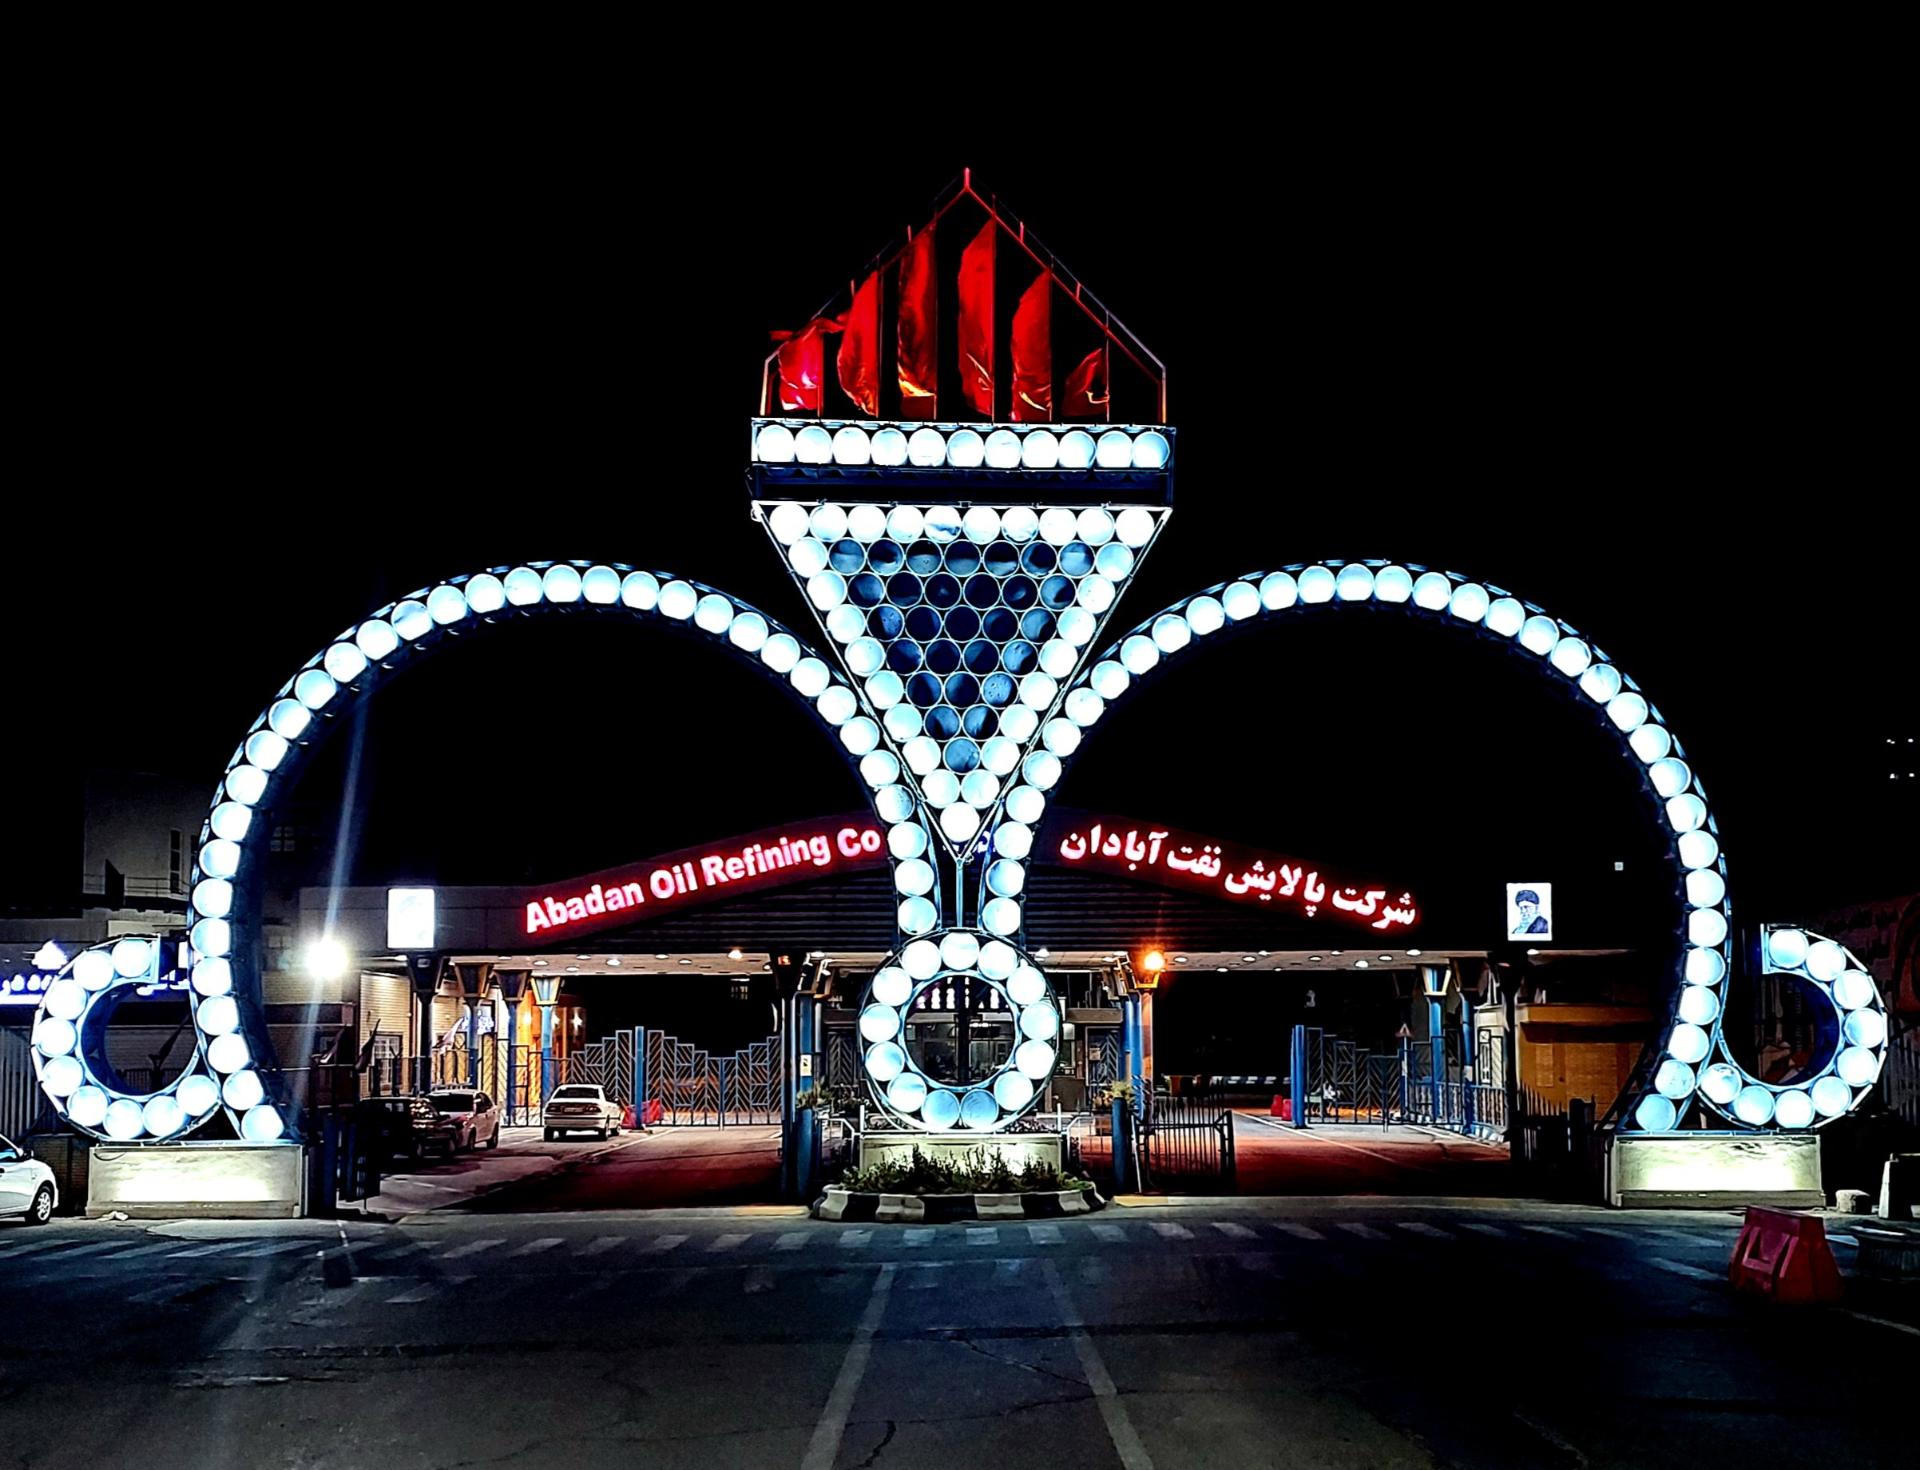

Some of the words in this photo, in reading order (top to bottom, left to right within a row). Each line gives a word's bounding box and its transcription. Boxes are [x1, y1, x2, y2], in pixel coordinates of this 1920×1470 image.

[1059, 825, 1169, 871] آبادان
[1166, 844, 1222, 878] نفت
[526, 883, 645, 934] Abadan
[649, 861, 698, 900] Oil
[700, 836, 832, 886] Refining
[836, 827, 881, 856] Co
[1332, 886, 1417, 929] شرکت
